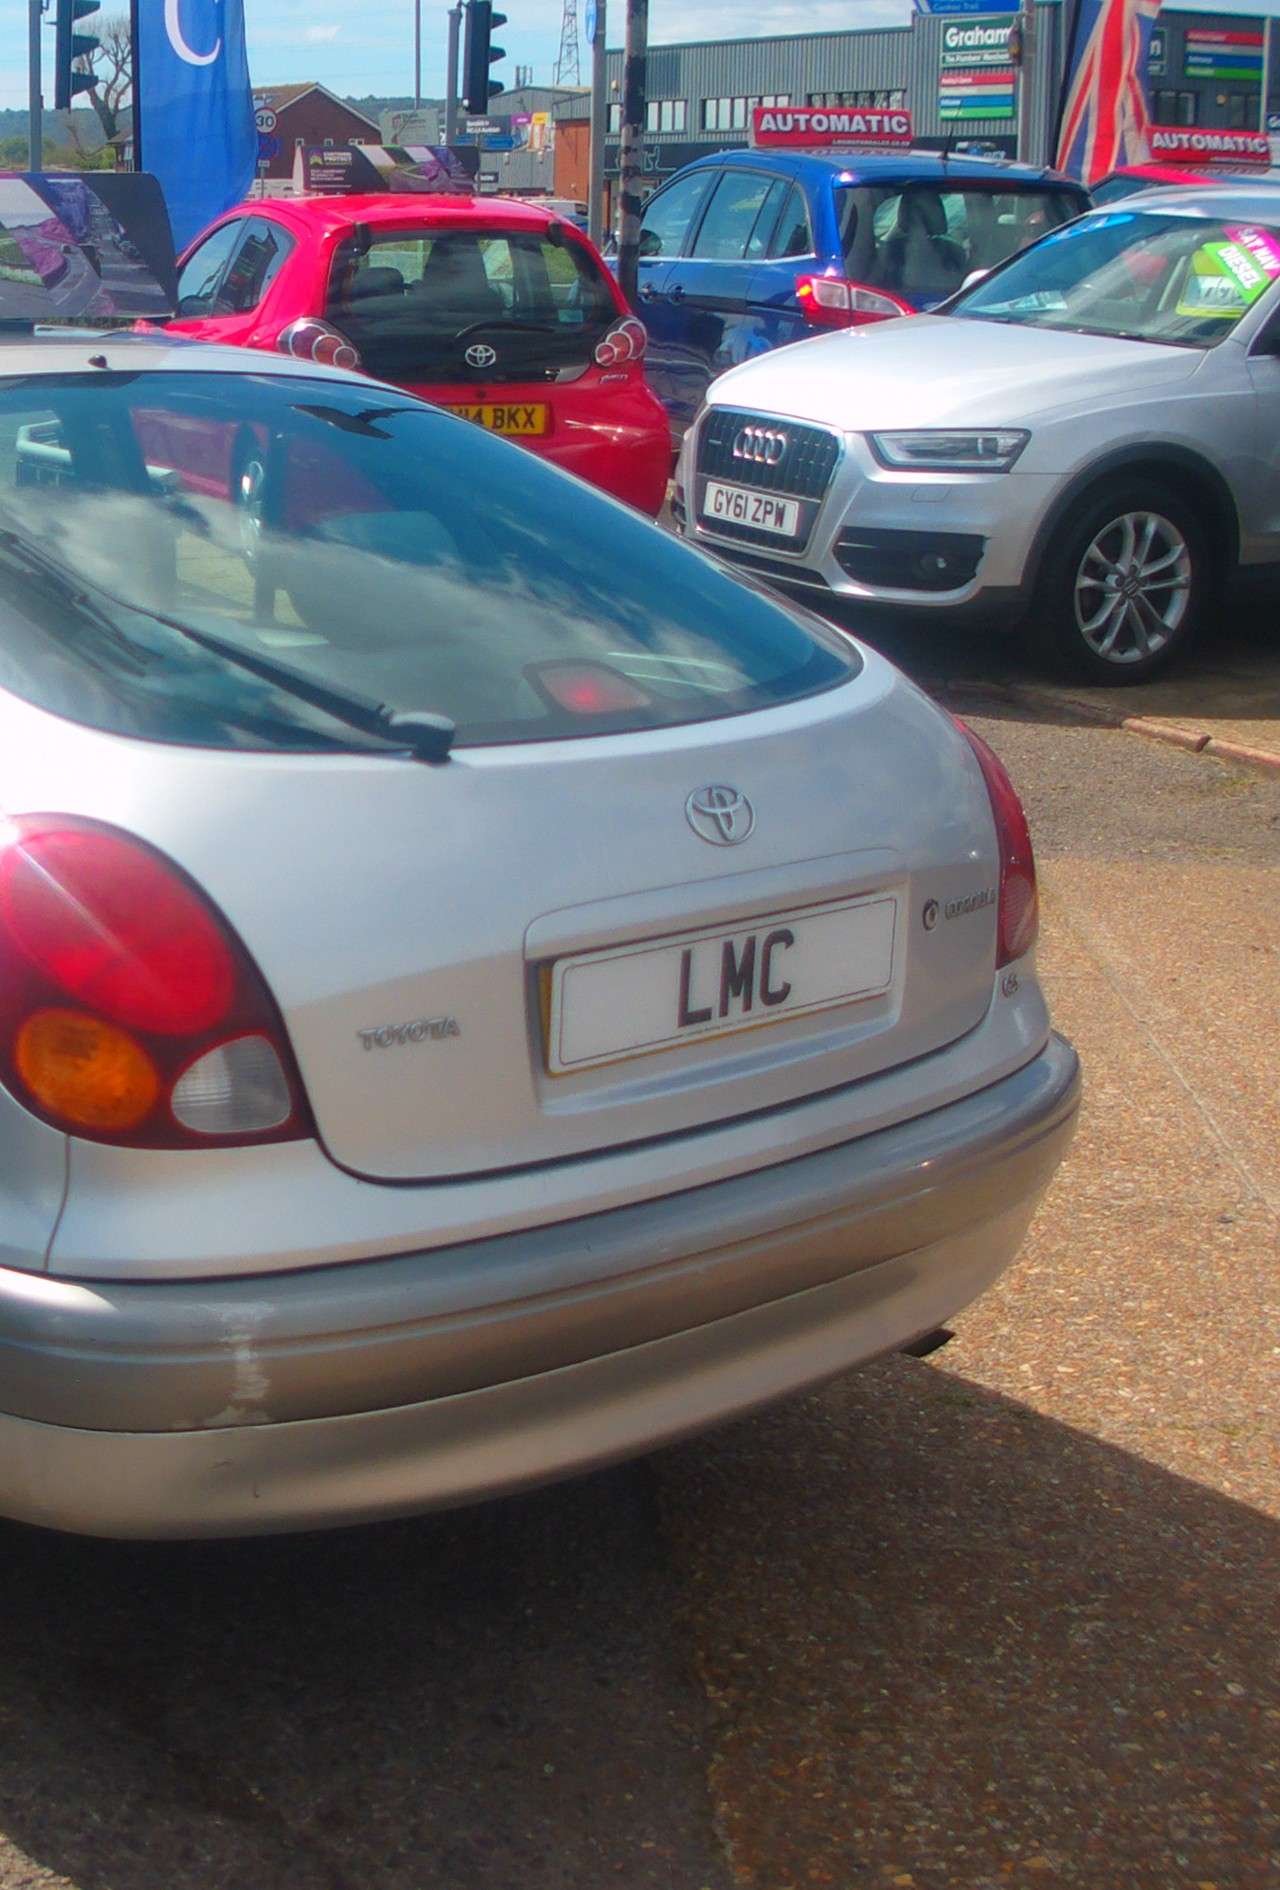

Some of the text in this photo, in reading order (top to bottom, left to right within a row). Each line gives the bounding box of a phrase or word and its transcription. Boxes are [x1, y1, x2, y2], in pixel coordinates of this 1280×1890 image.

[256, 115, 274, 128] 30
[760, 113, 908, 134] AUTOMATIC
[1152, 133, 1267, 153] AUTOMATIC
[1217, 245, 1262, 289] DIESEL
[492, 408, 536, 429] BKX
[713, 489, 749, 520] GY61
[677, 929, 795, 1028] LMC
[356, 1016, 461, 1051] TOYOTA
